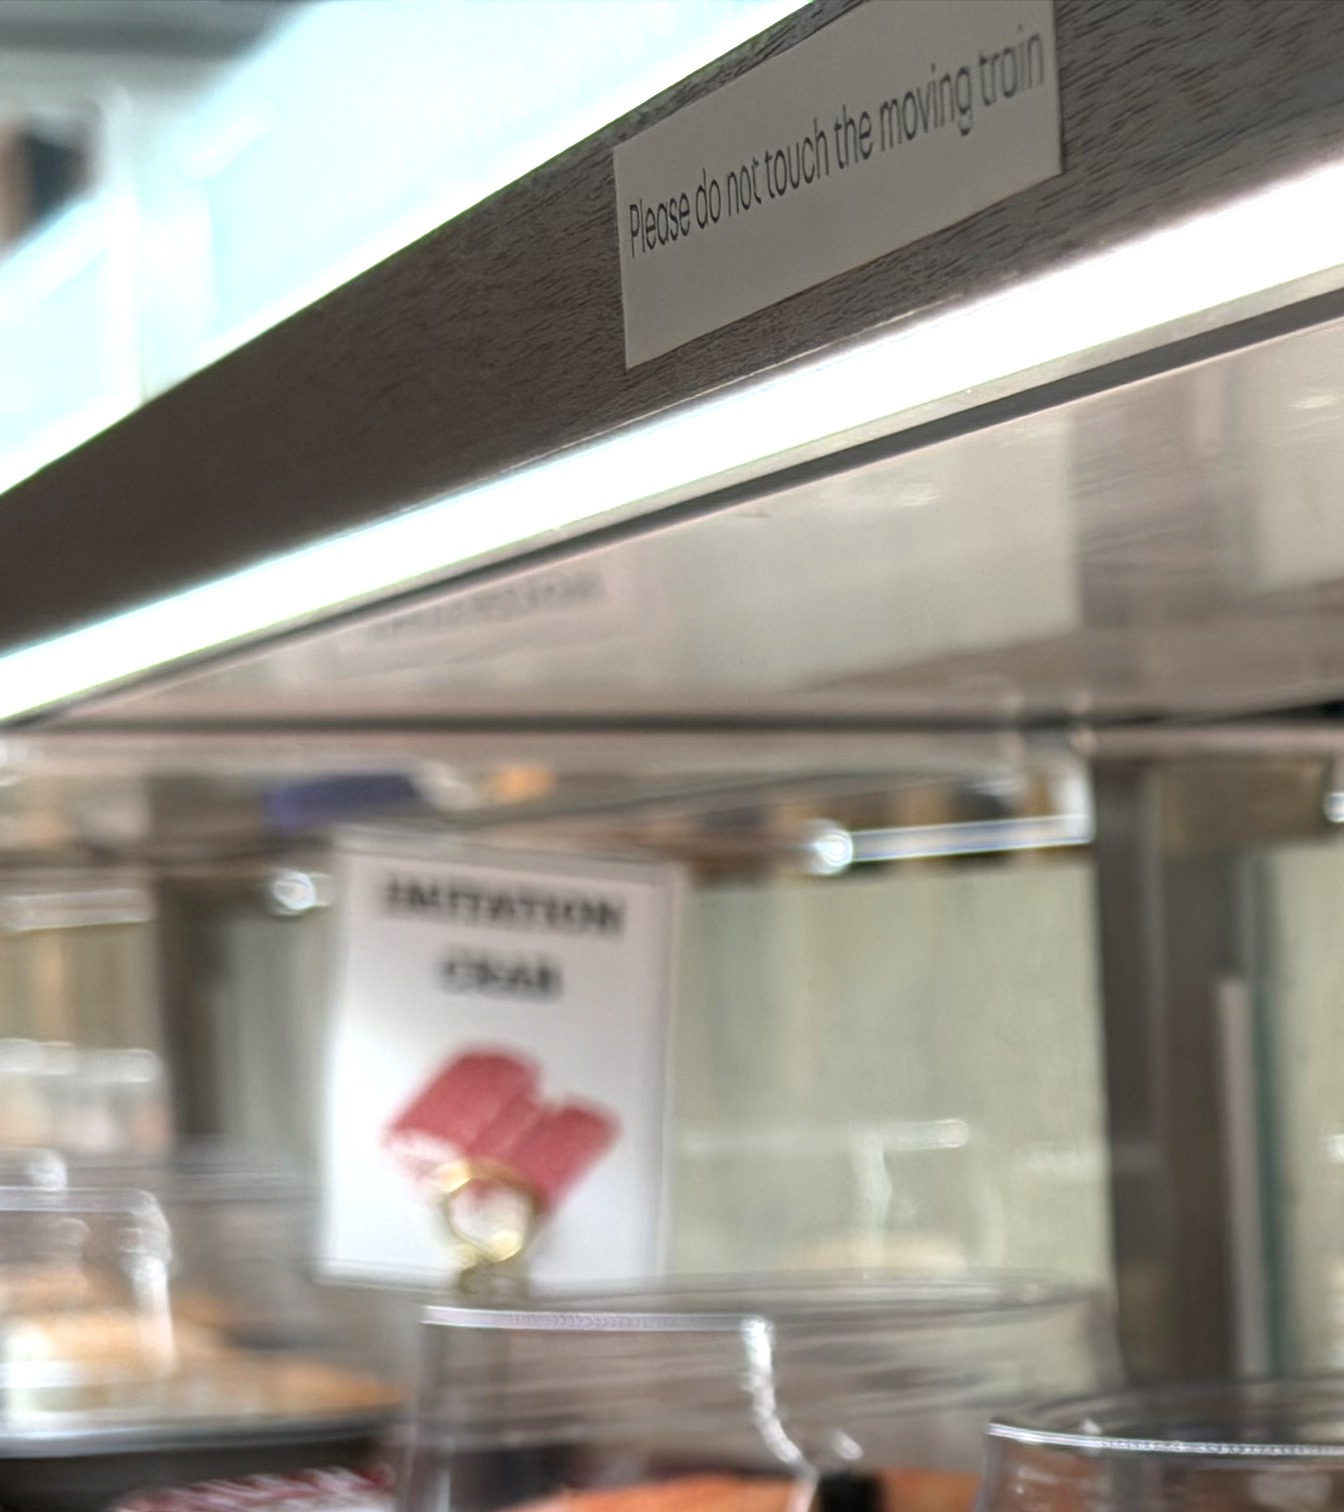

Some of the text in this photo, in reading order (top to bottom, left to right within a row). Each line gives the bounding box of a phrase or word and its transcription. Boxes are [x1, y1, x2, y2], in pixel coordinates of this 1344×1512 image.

[629, 23, 1044, 258] Please do not touch the moving train
[382, 875, 624, 938] IMITATION
